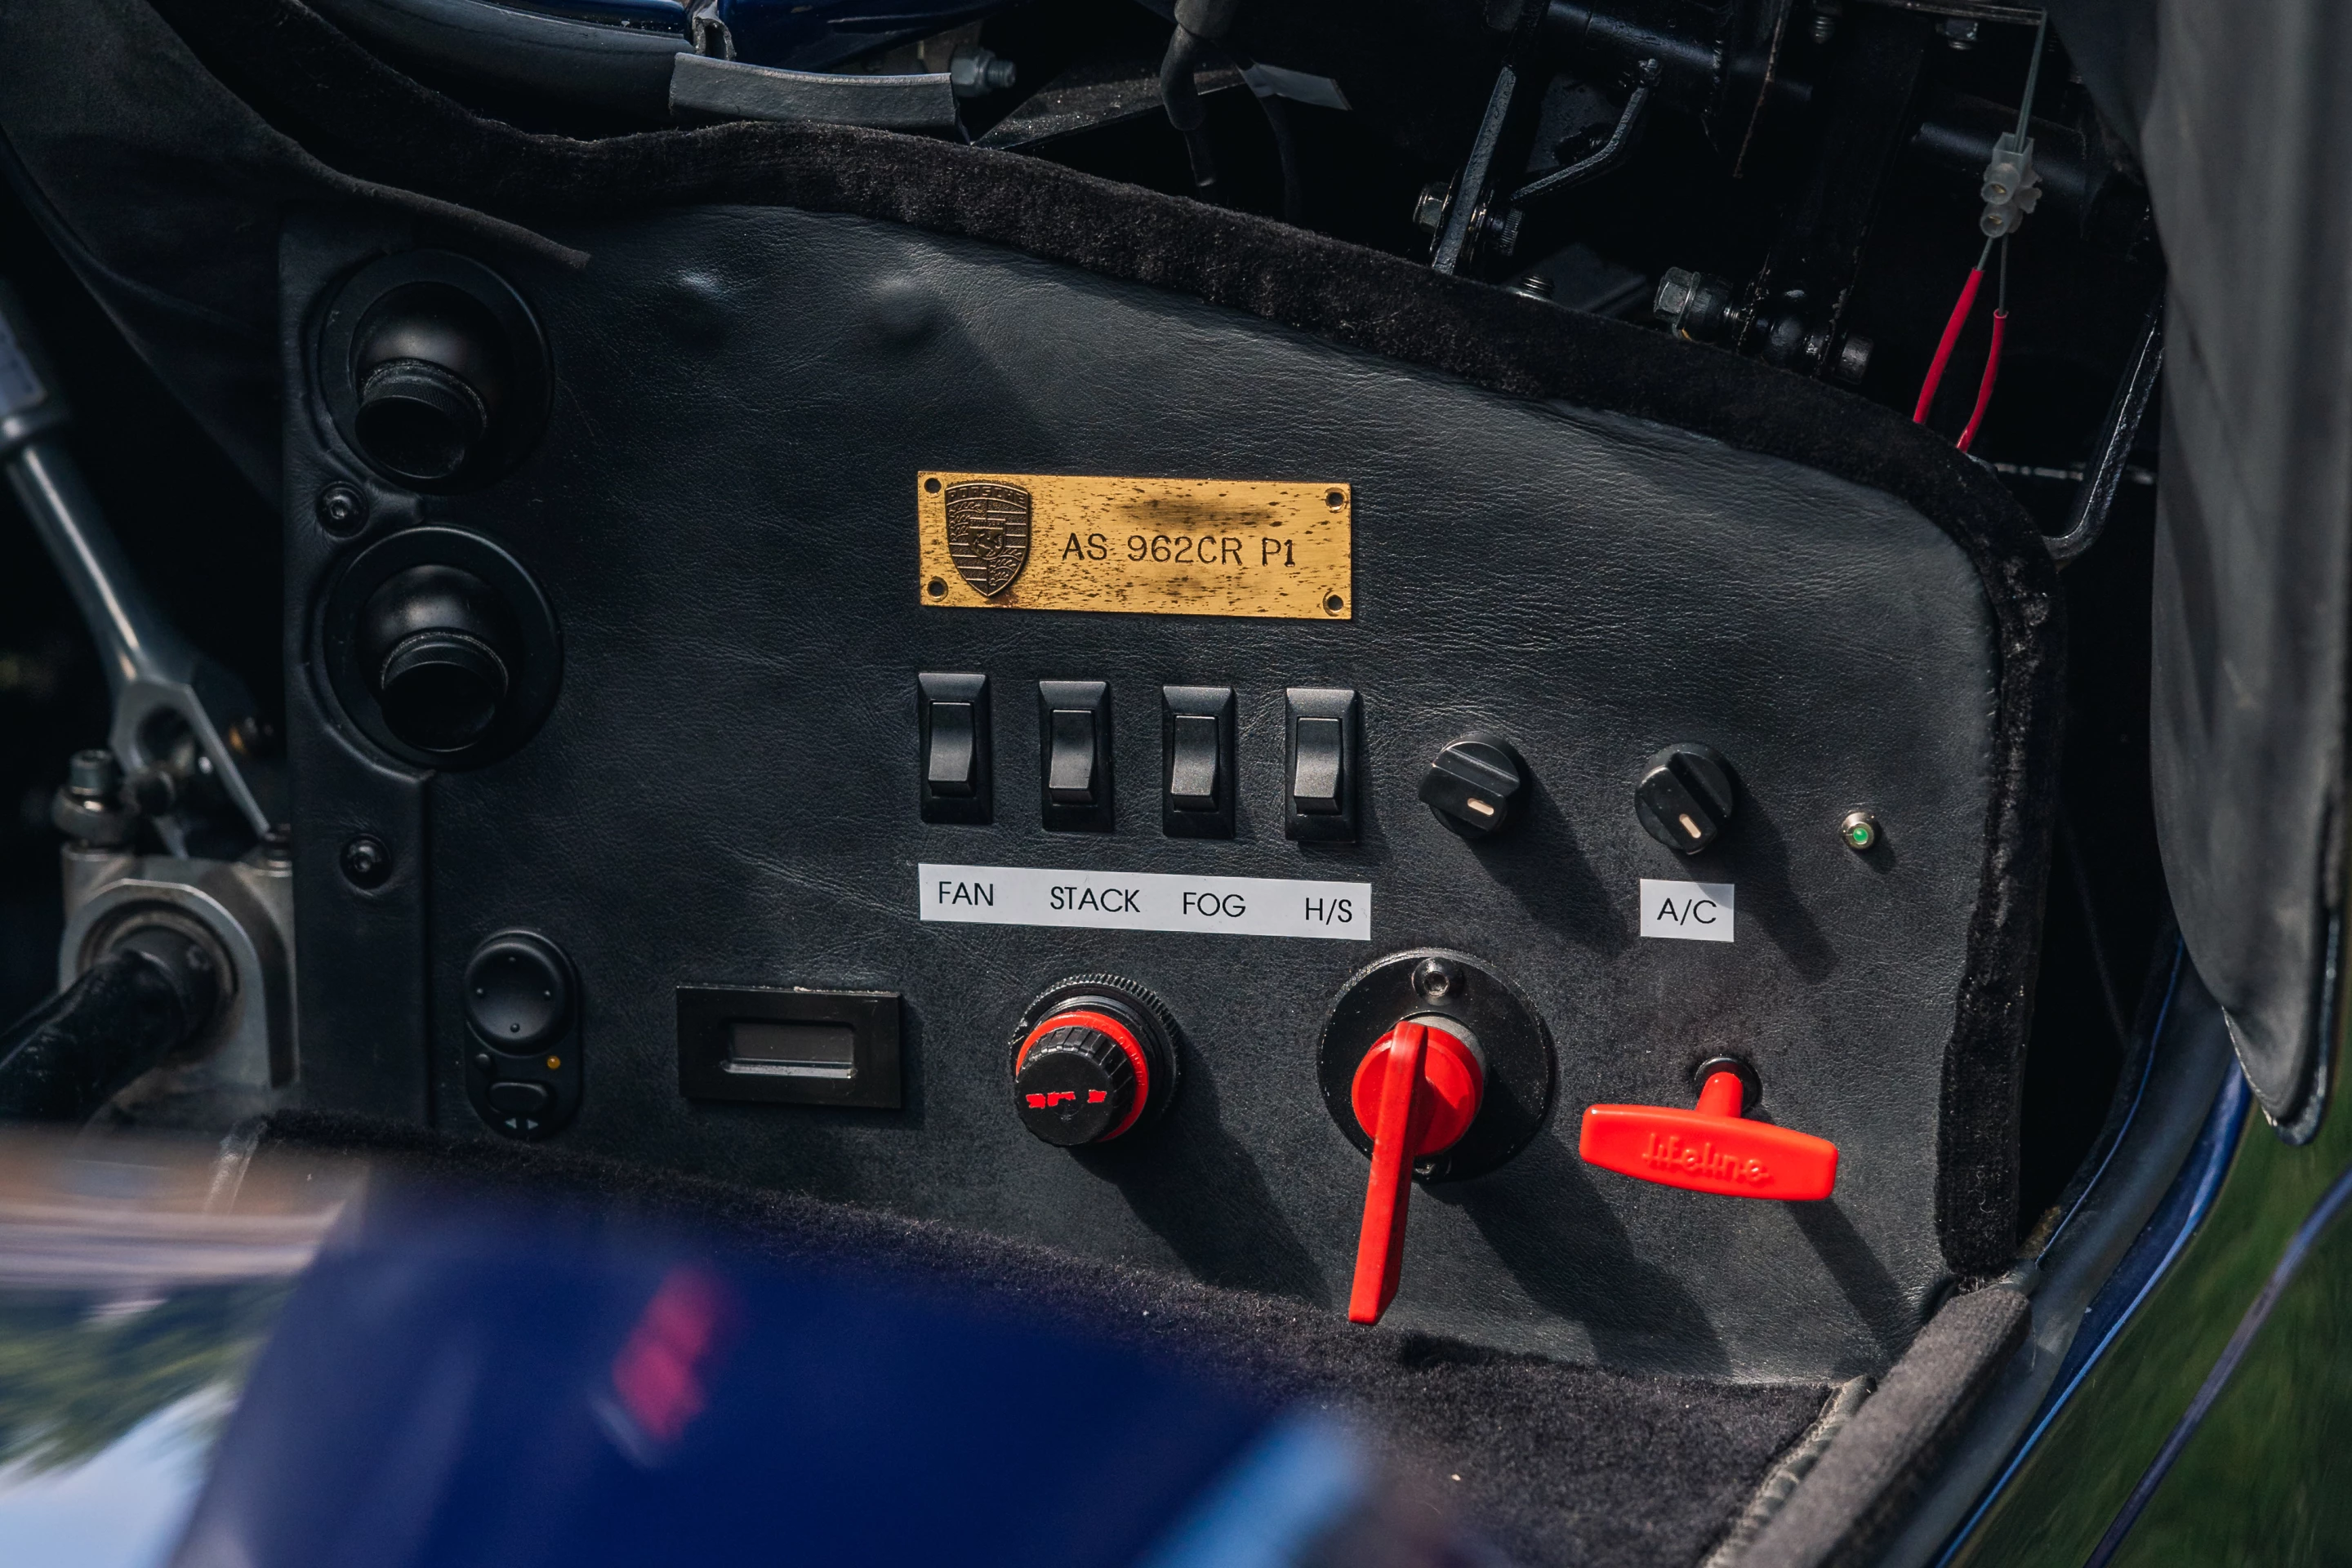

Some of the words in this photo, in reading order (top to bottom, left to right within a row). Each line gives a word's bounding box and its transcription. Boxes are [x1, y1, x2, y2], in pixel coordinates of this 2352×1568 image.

[1062, 532, 1108, 561] AS
[1126, 534, 1244, 567] 962CR
[1262, 537, 1296, 568] P1
[939, 881, 993, 906] FAN
[1050, 886, 1140, 912] STACK
[1183, 892, 1245, 917] FOG
[1306, 898, 1352, 924] H/S
[1657, 898, 1716, 925] A/C
[1642, 1132, 1771, 1182] lifeline
